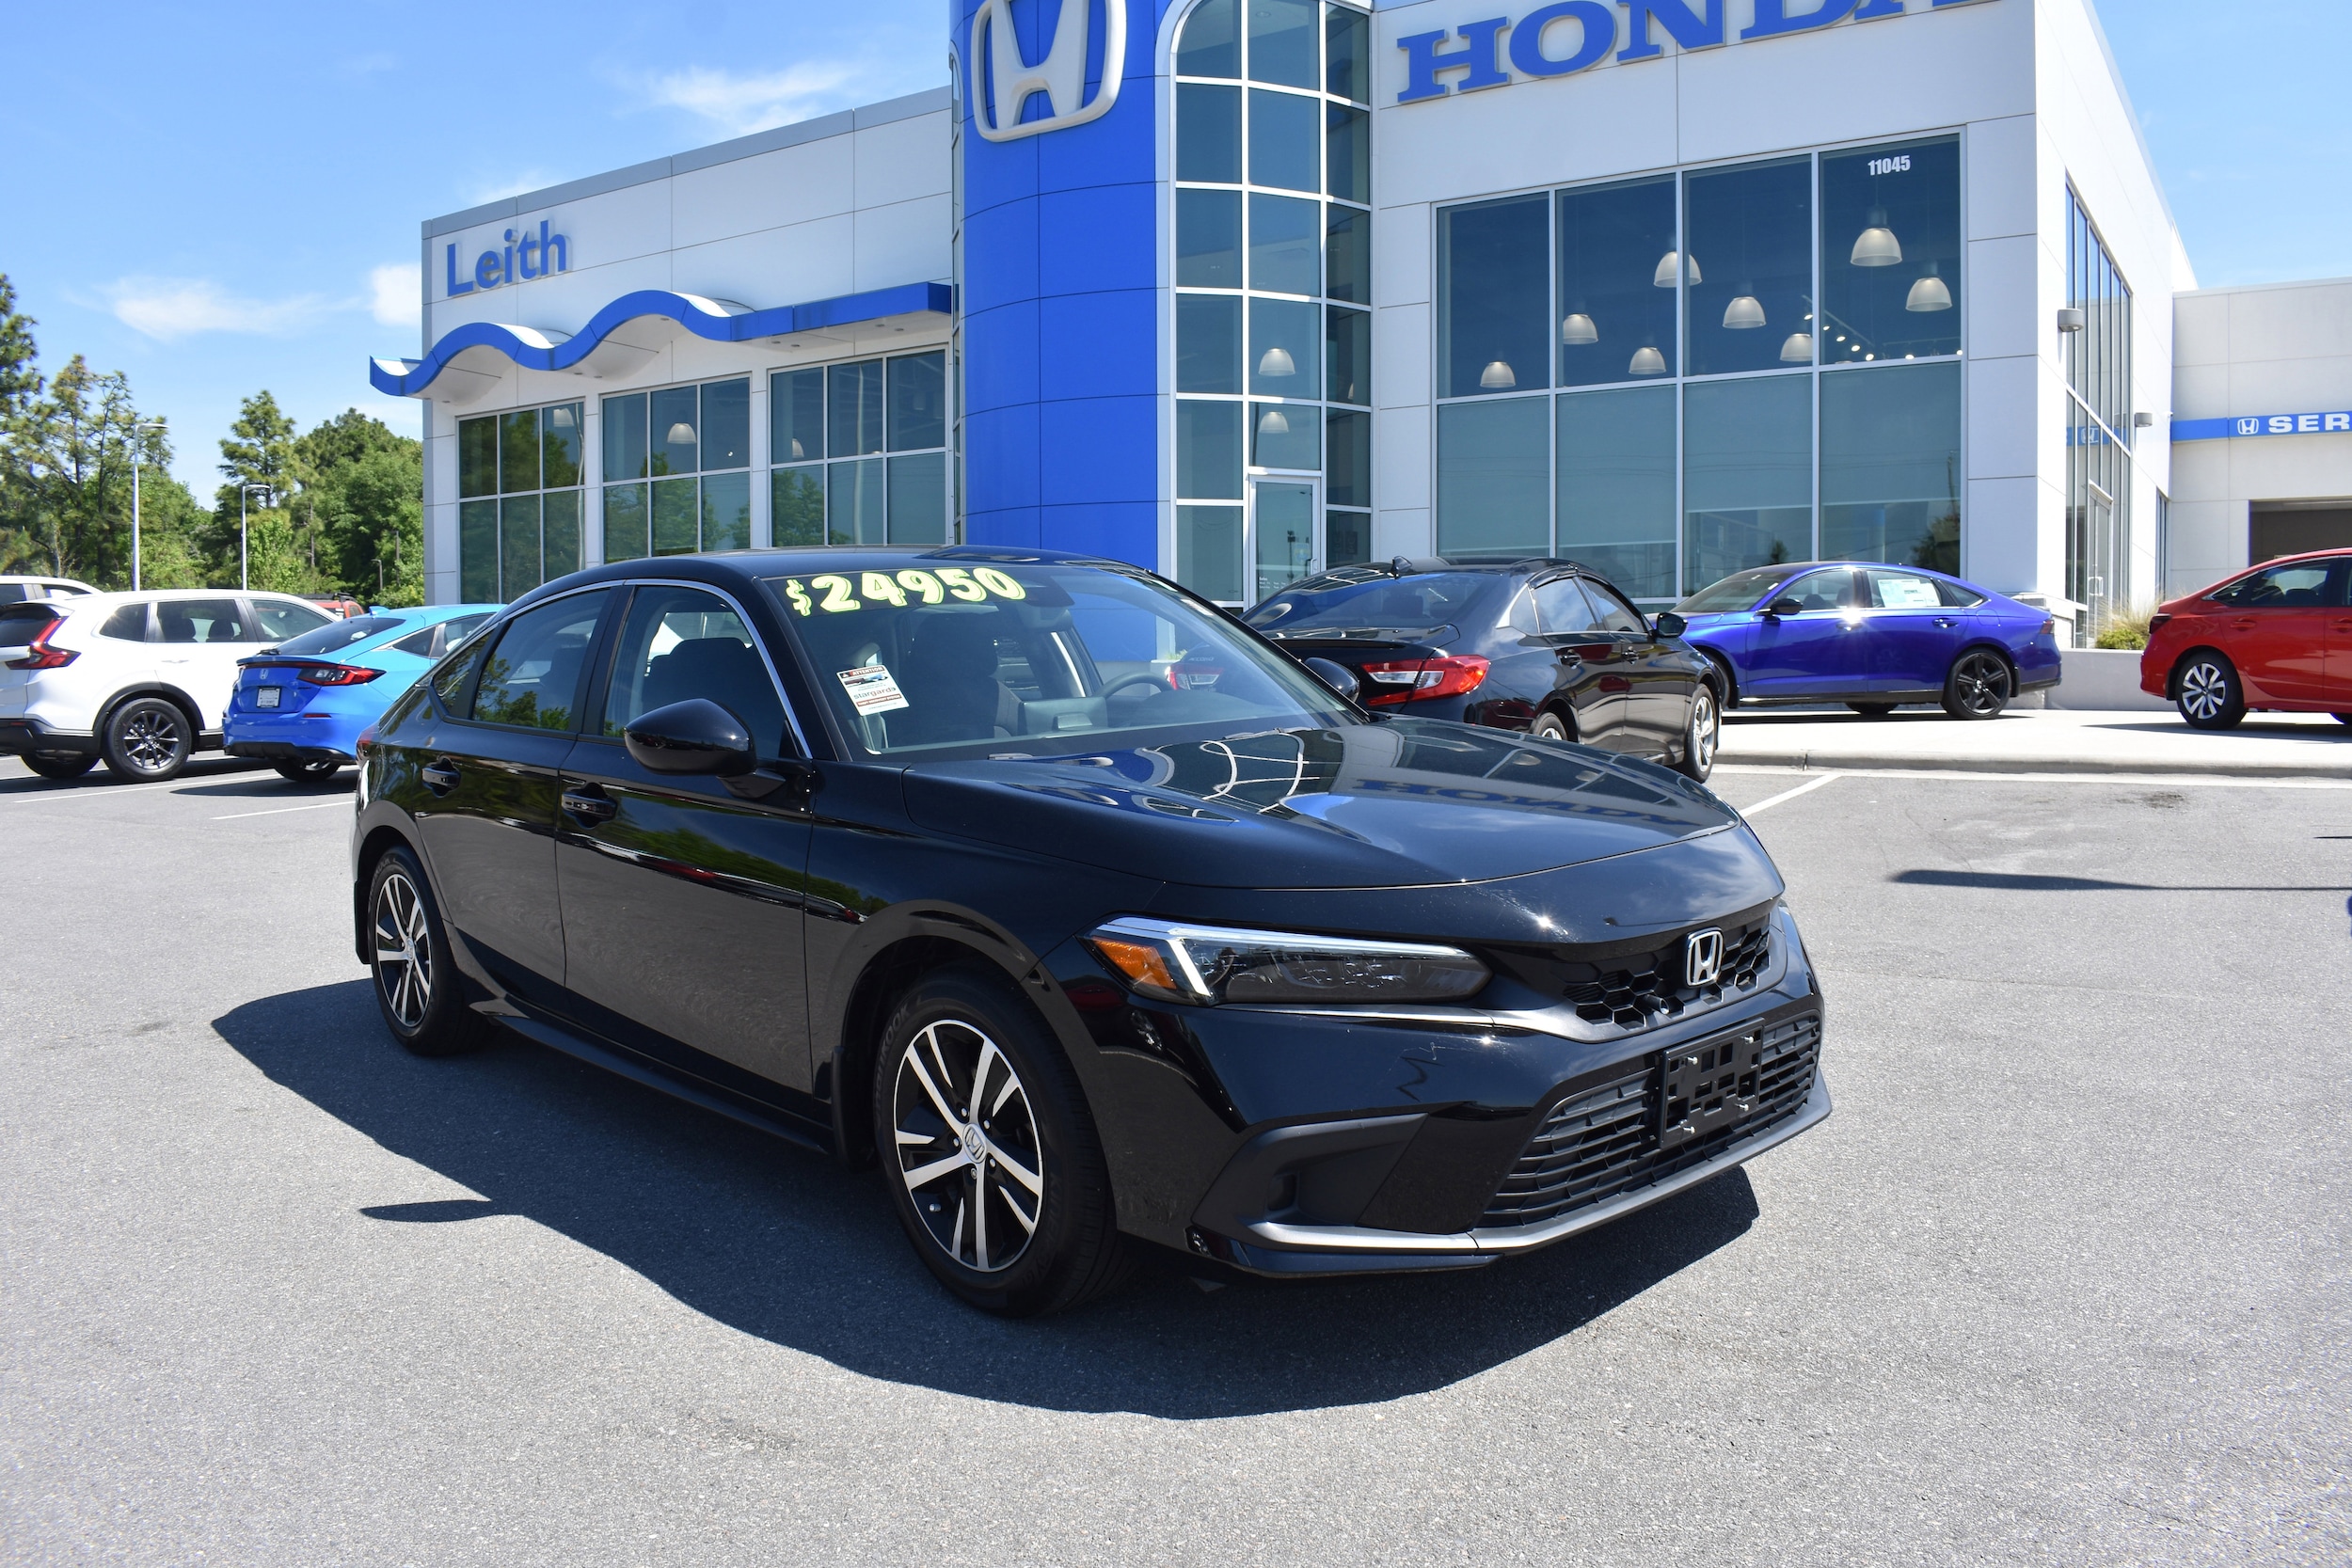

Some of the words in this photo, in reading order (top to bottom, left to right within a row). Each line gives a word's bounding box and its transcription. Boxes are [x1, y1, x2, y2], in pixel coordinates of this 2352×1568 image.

[1397, 0, 1985, 103] HOND
[1867, 155, 1911, 176] 11045
[447, 219, 569, 297] Leith
[786, 567, 1026, 617] $24950
[852, 666, 883, 675] ATTENTION
